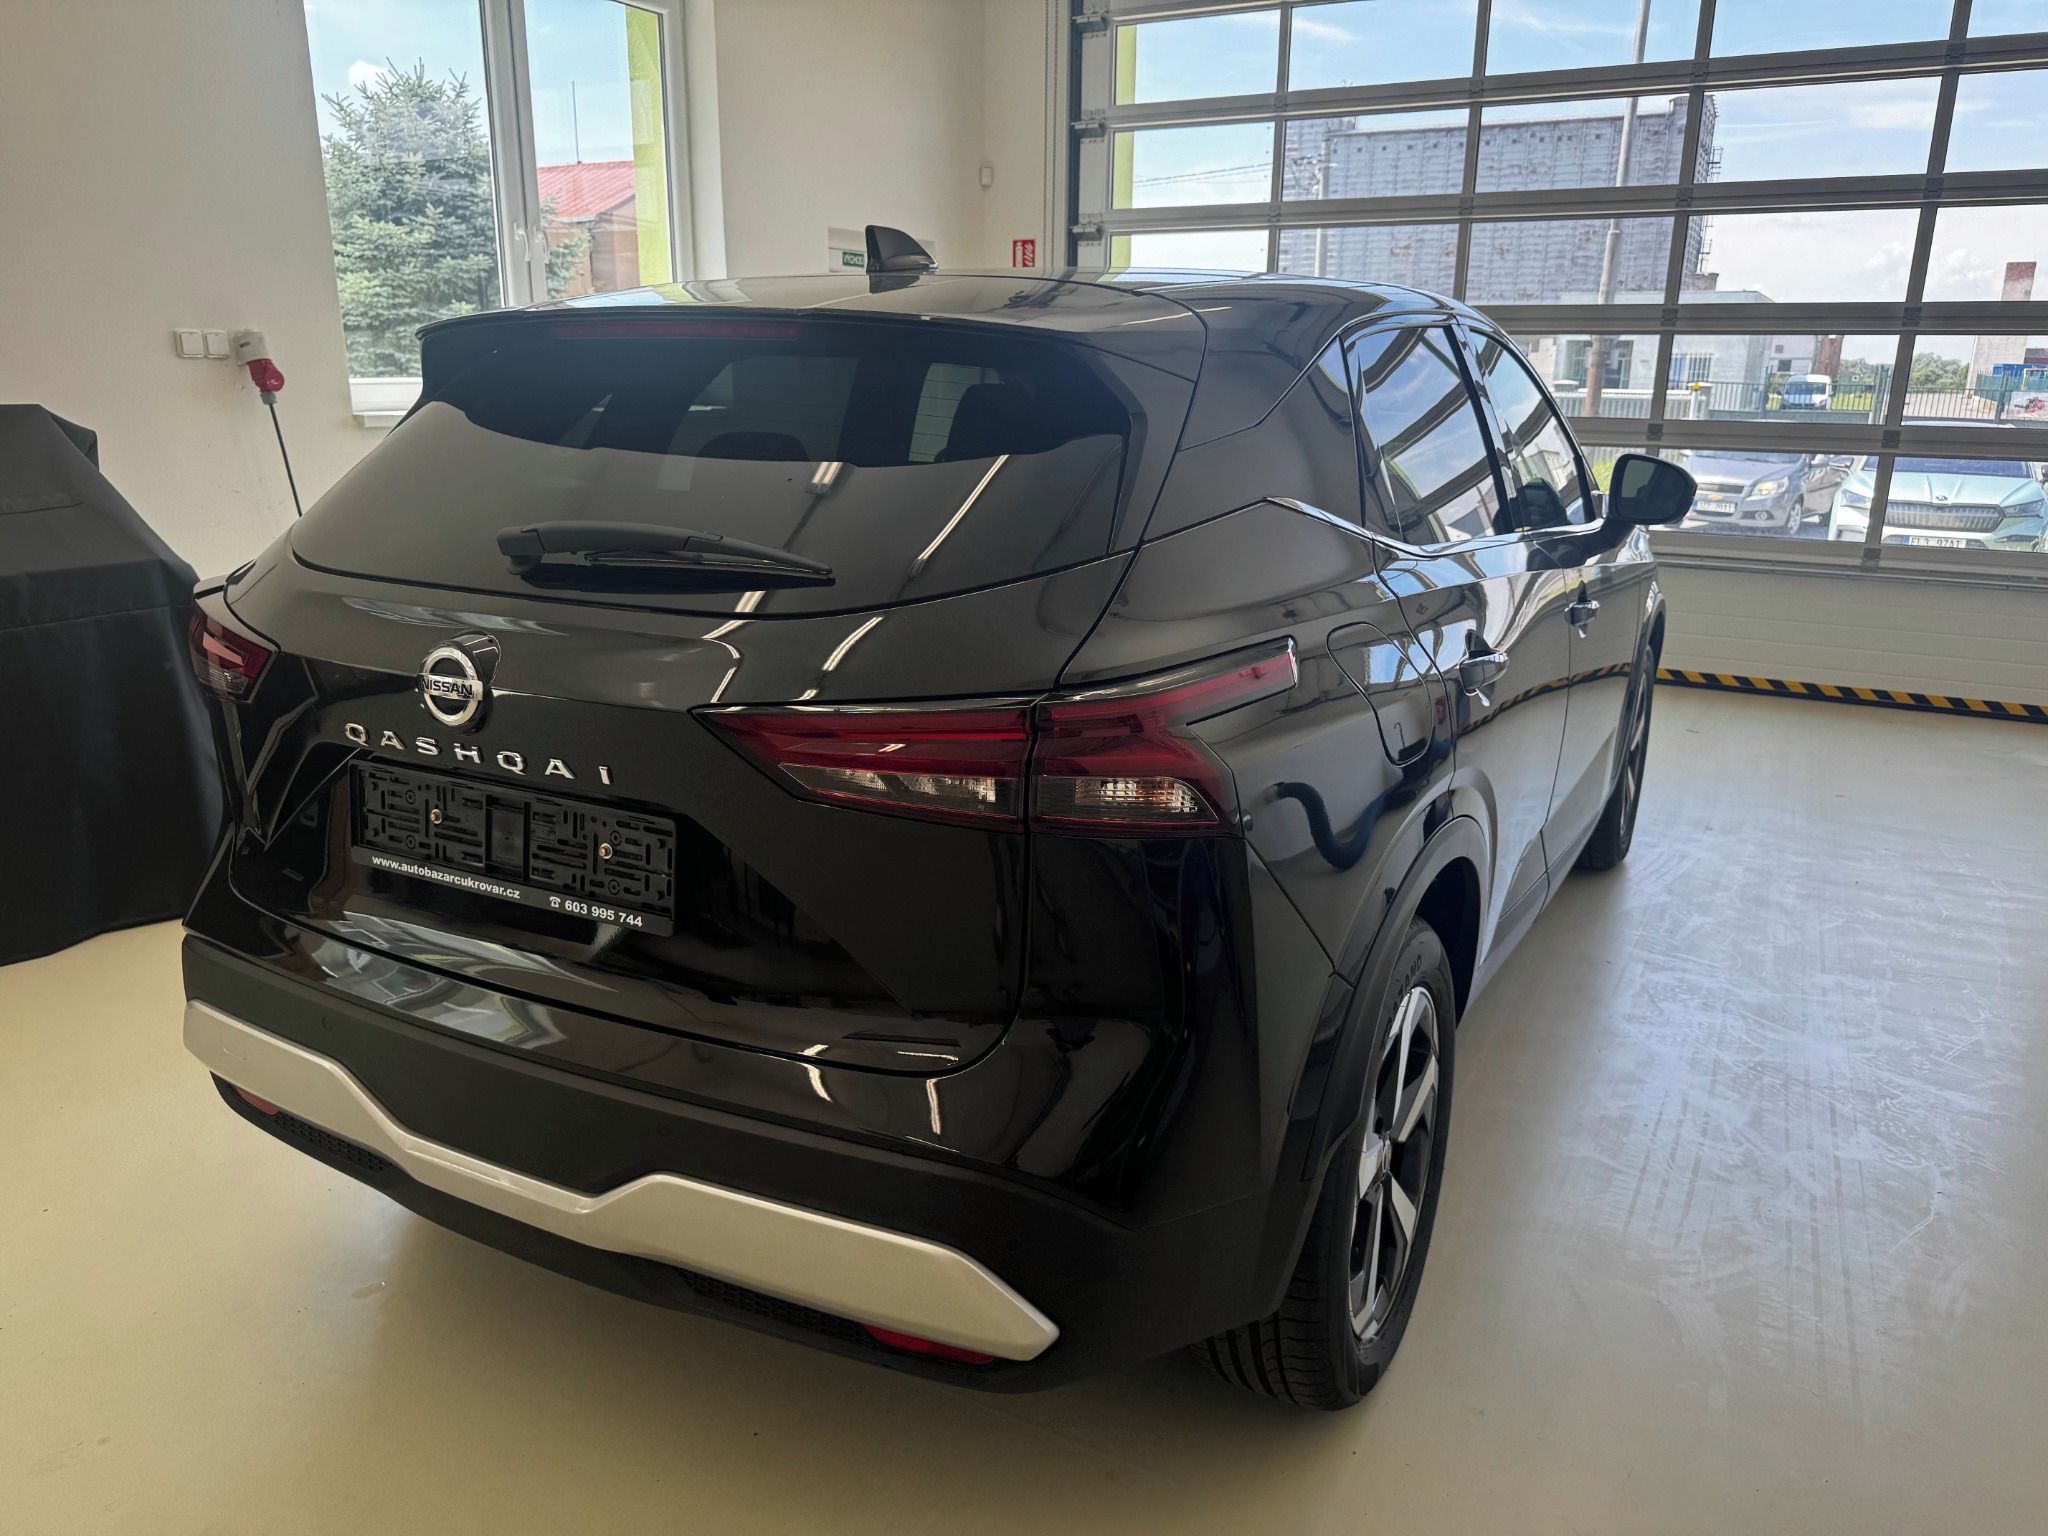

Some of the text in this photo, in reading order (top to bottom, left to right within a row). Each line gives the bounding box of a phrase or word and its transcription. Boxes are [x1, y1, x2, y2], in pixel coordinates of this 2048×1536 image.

[421, 678, 473, 696] NISSAN
[344, 723, 613, 785] QASHQAI
[372, 856, 521, 898] www.autobazarcukrovar.cz
[564, 900, 643, 927] 603 995 744
